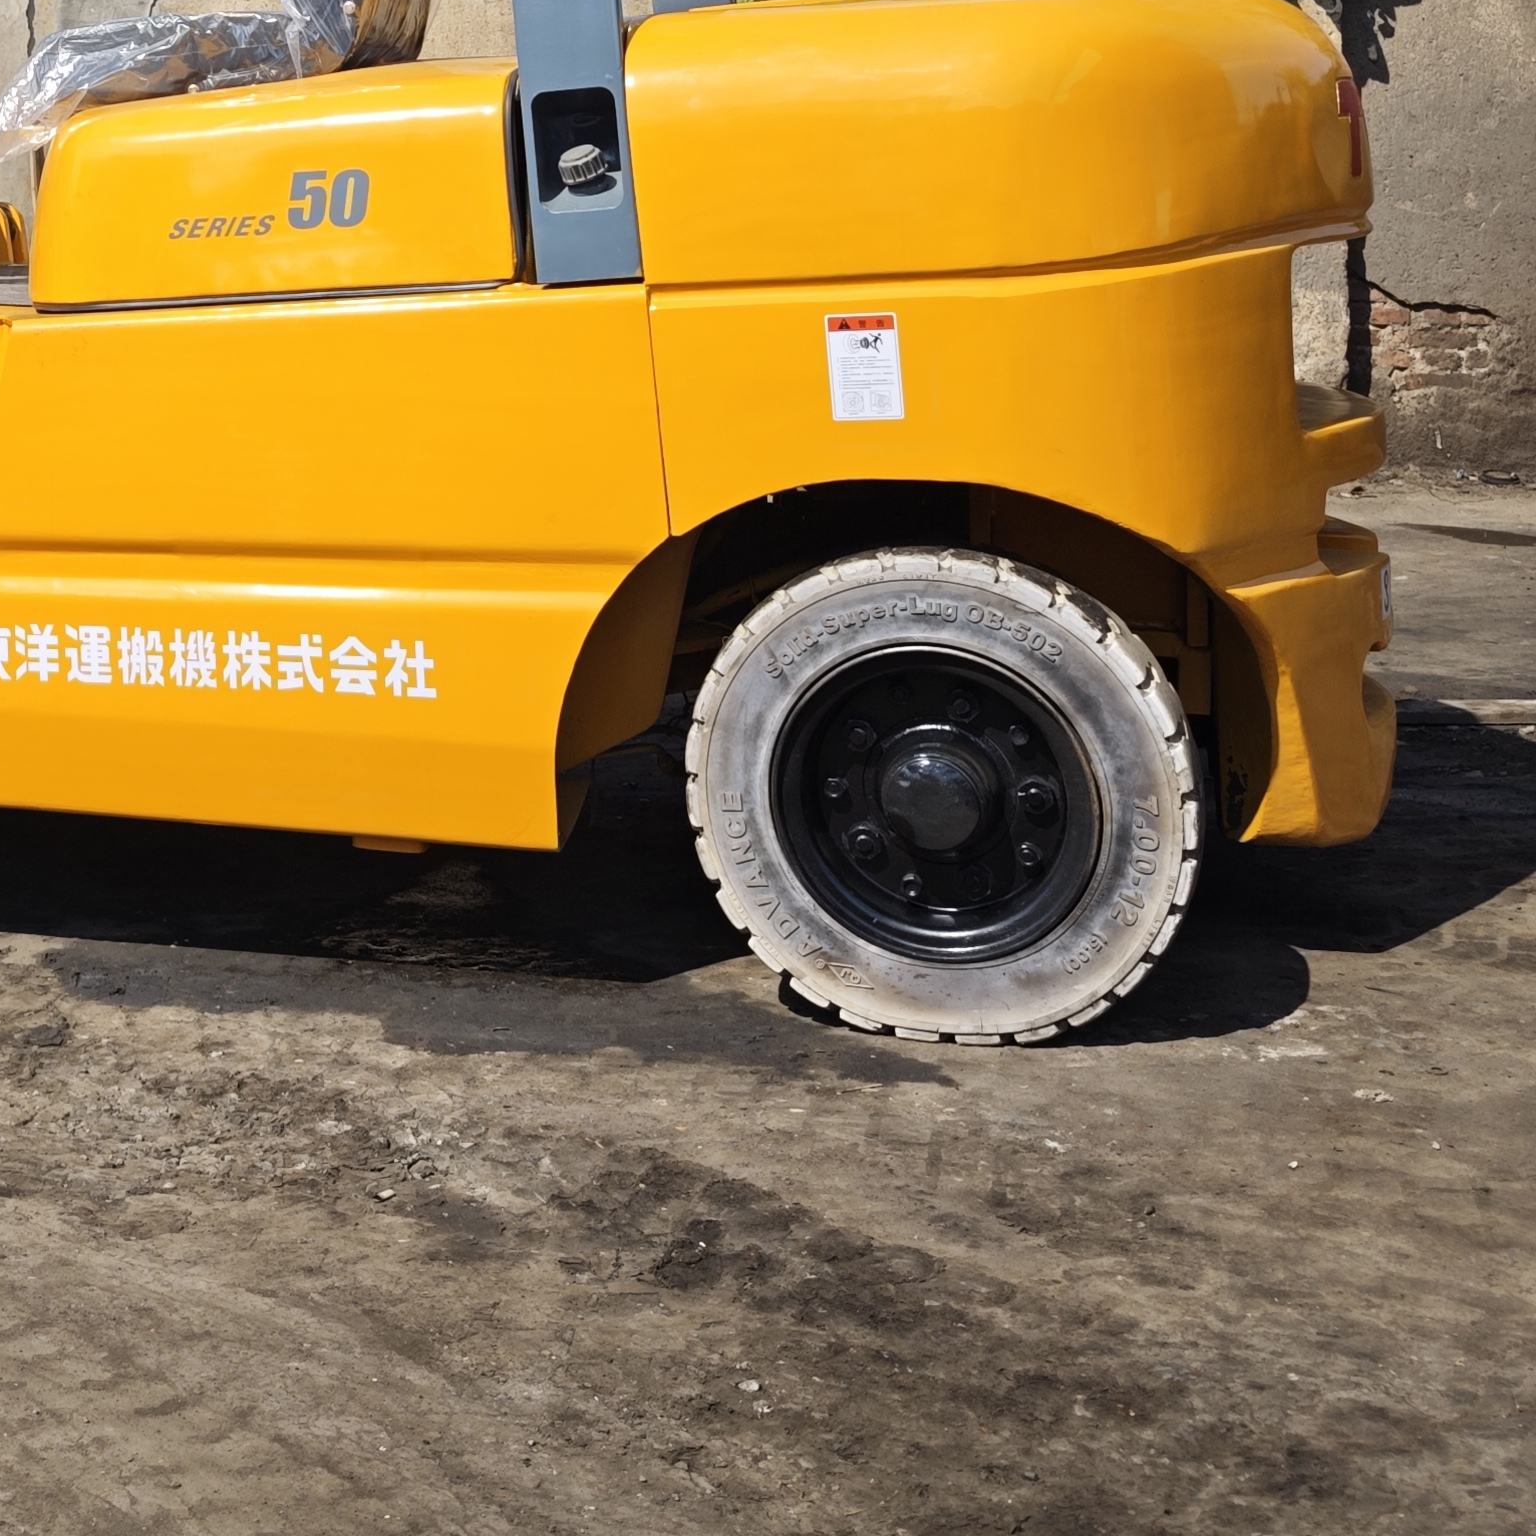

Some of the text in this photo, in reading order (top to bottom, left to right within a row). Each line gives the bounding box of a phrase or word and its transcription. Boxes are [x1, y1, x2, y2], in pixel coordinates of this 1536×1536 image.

[168, 168, 370, 240] SERIES 50
[765, 595, 1063, 678] Solid-Super-Lug OB-502
[722, 791, 824, 958] ADVANCE
[1111, 794, 1161, 927] 7.00-12
[1064, 930, 1108, 975] (5.00)
